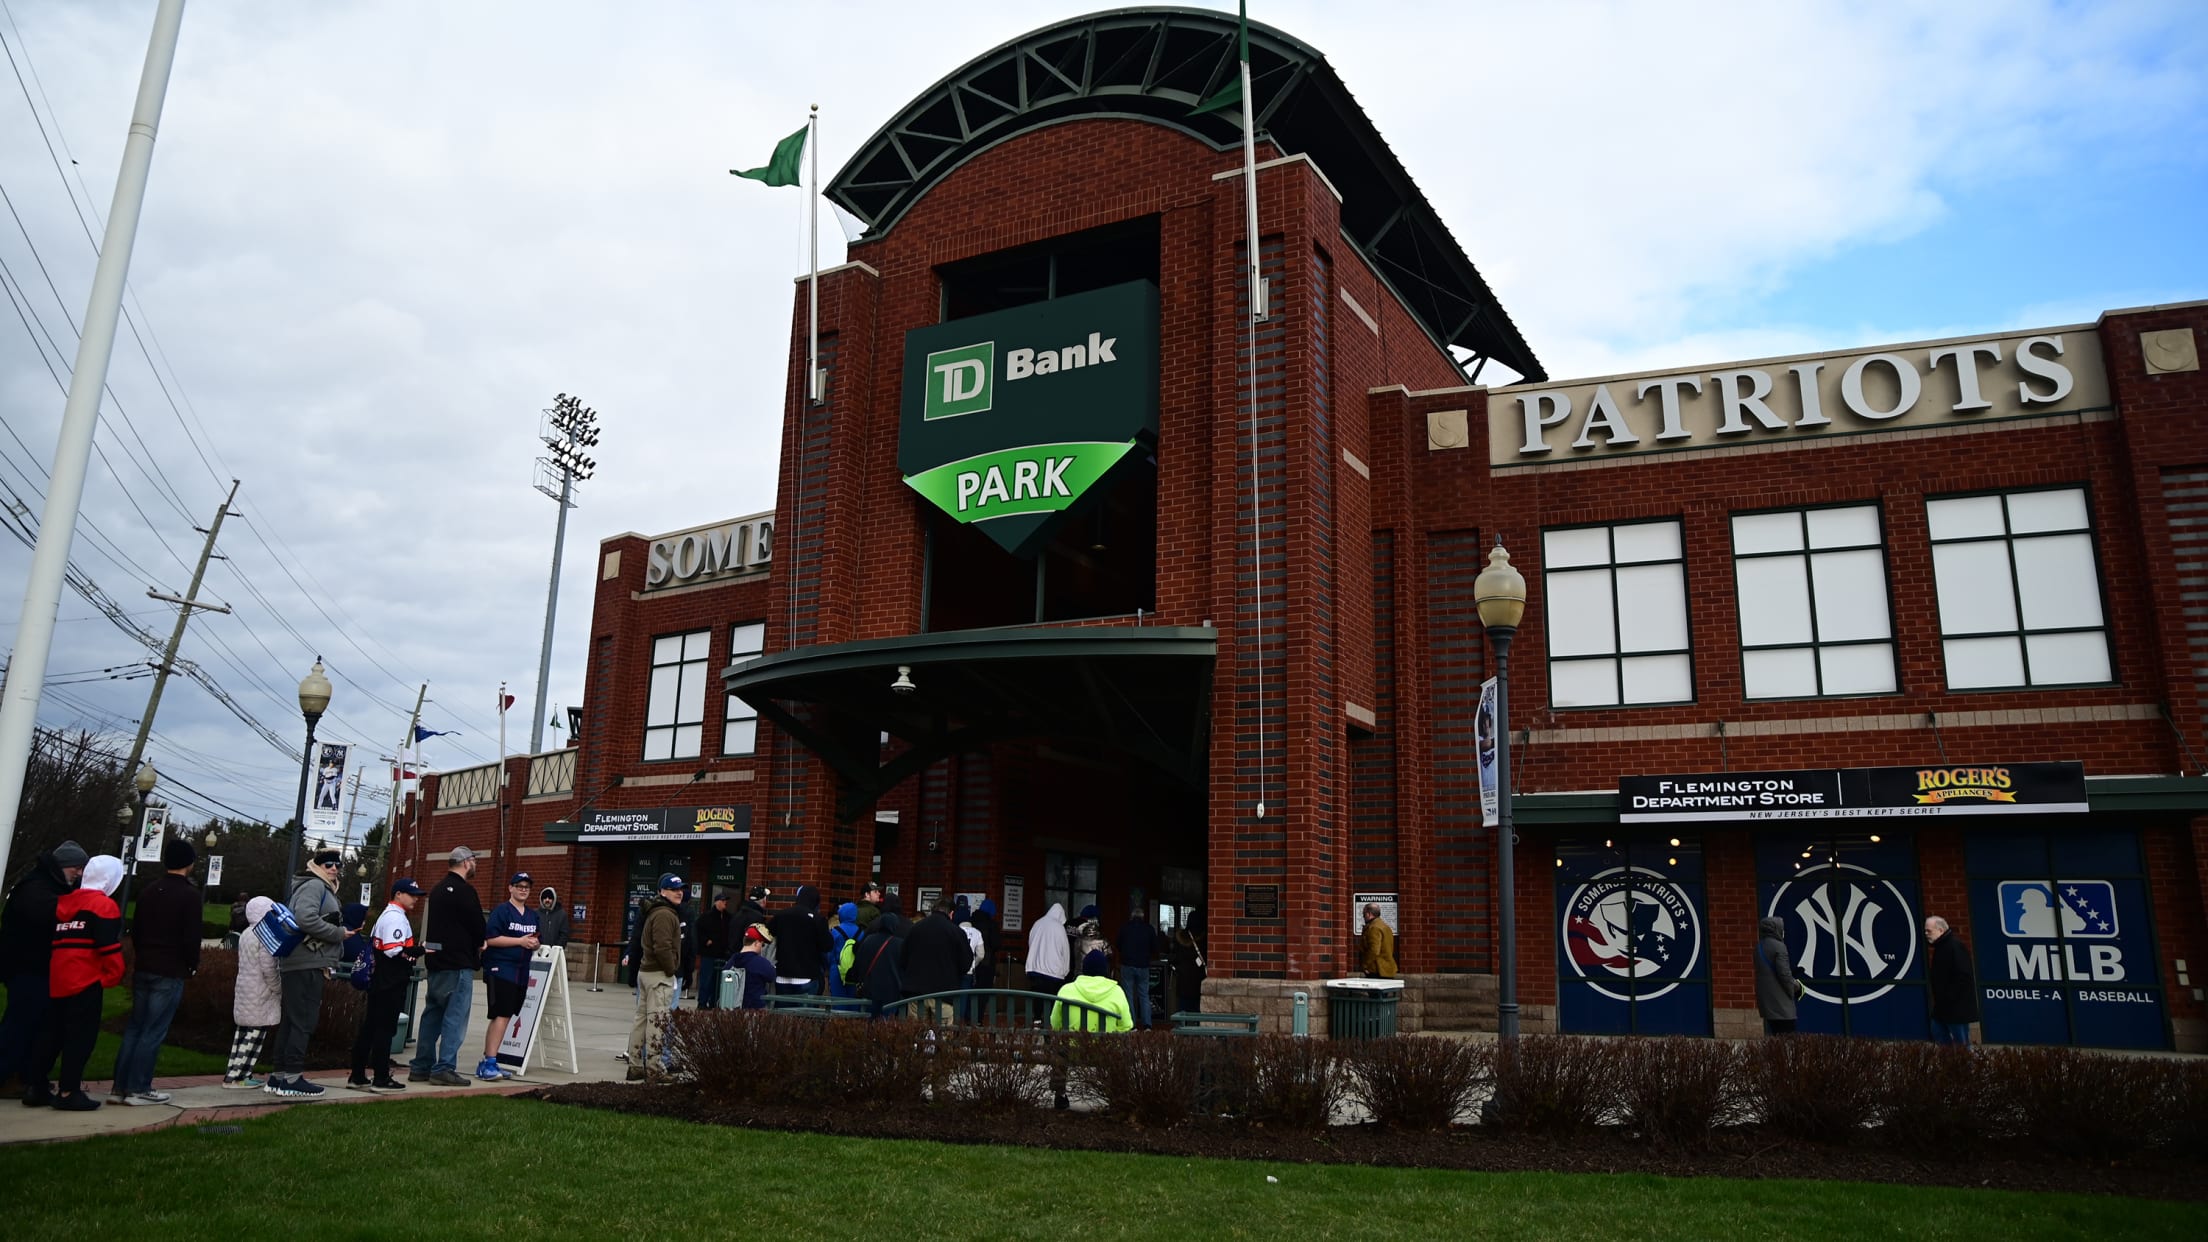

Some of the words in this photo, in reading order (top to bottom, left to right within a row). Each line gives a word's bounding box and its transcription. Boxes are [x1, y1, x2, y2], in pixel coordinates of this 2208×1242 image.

[933, 358, 986, 404] TD
[1006, 332, 1118, 382] Bank
[1515, 335, 2075, 454] PATRIOTS
[956, 455, 1077, 512] PARK
[647, 522, 773, 586] SOME
[1659, 780, 1794, 794] FLEMINGTON
[1916, 767, 2012, 791] ROGER'S
[1632, 795, 1757, 809] DEPARTMENT
[1759, 792, 1825, 805] STORE
[1935, 788, 1993, 799] APPLIANCES
[595, 814, 649, 823] FLEMINGTON
[1749, 811, 1773, 819] NEW
[1777, 810, 1829, 818] JERSEY'S
[1834, 809, 1862, 817] BEST
[1867, 808, 1894, 816] KEPT
[1899, 807, 1943, 815] SECRET
[584, 823, 633, 832] DEPARTMENT
[1636, 876, 1686, 918] ATRIOTS
[2006, 944, 2126, 982] MiLB
[1986, 988, 2041, 1001] DOUBLE
[2079, 990, 2154, 1004] BASEBALL
